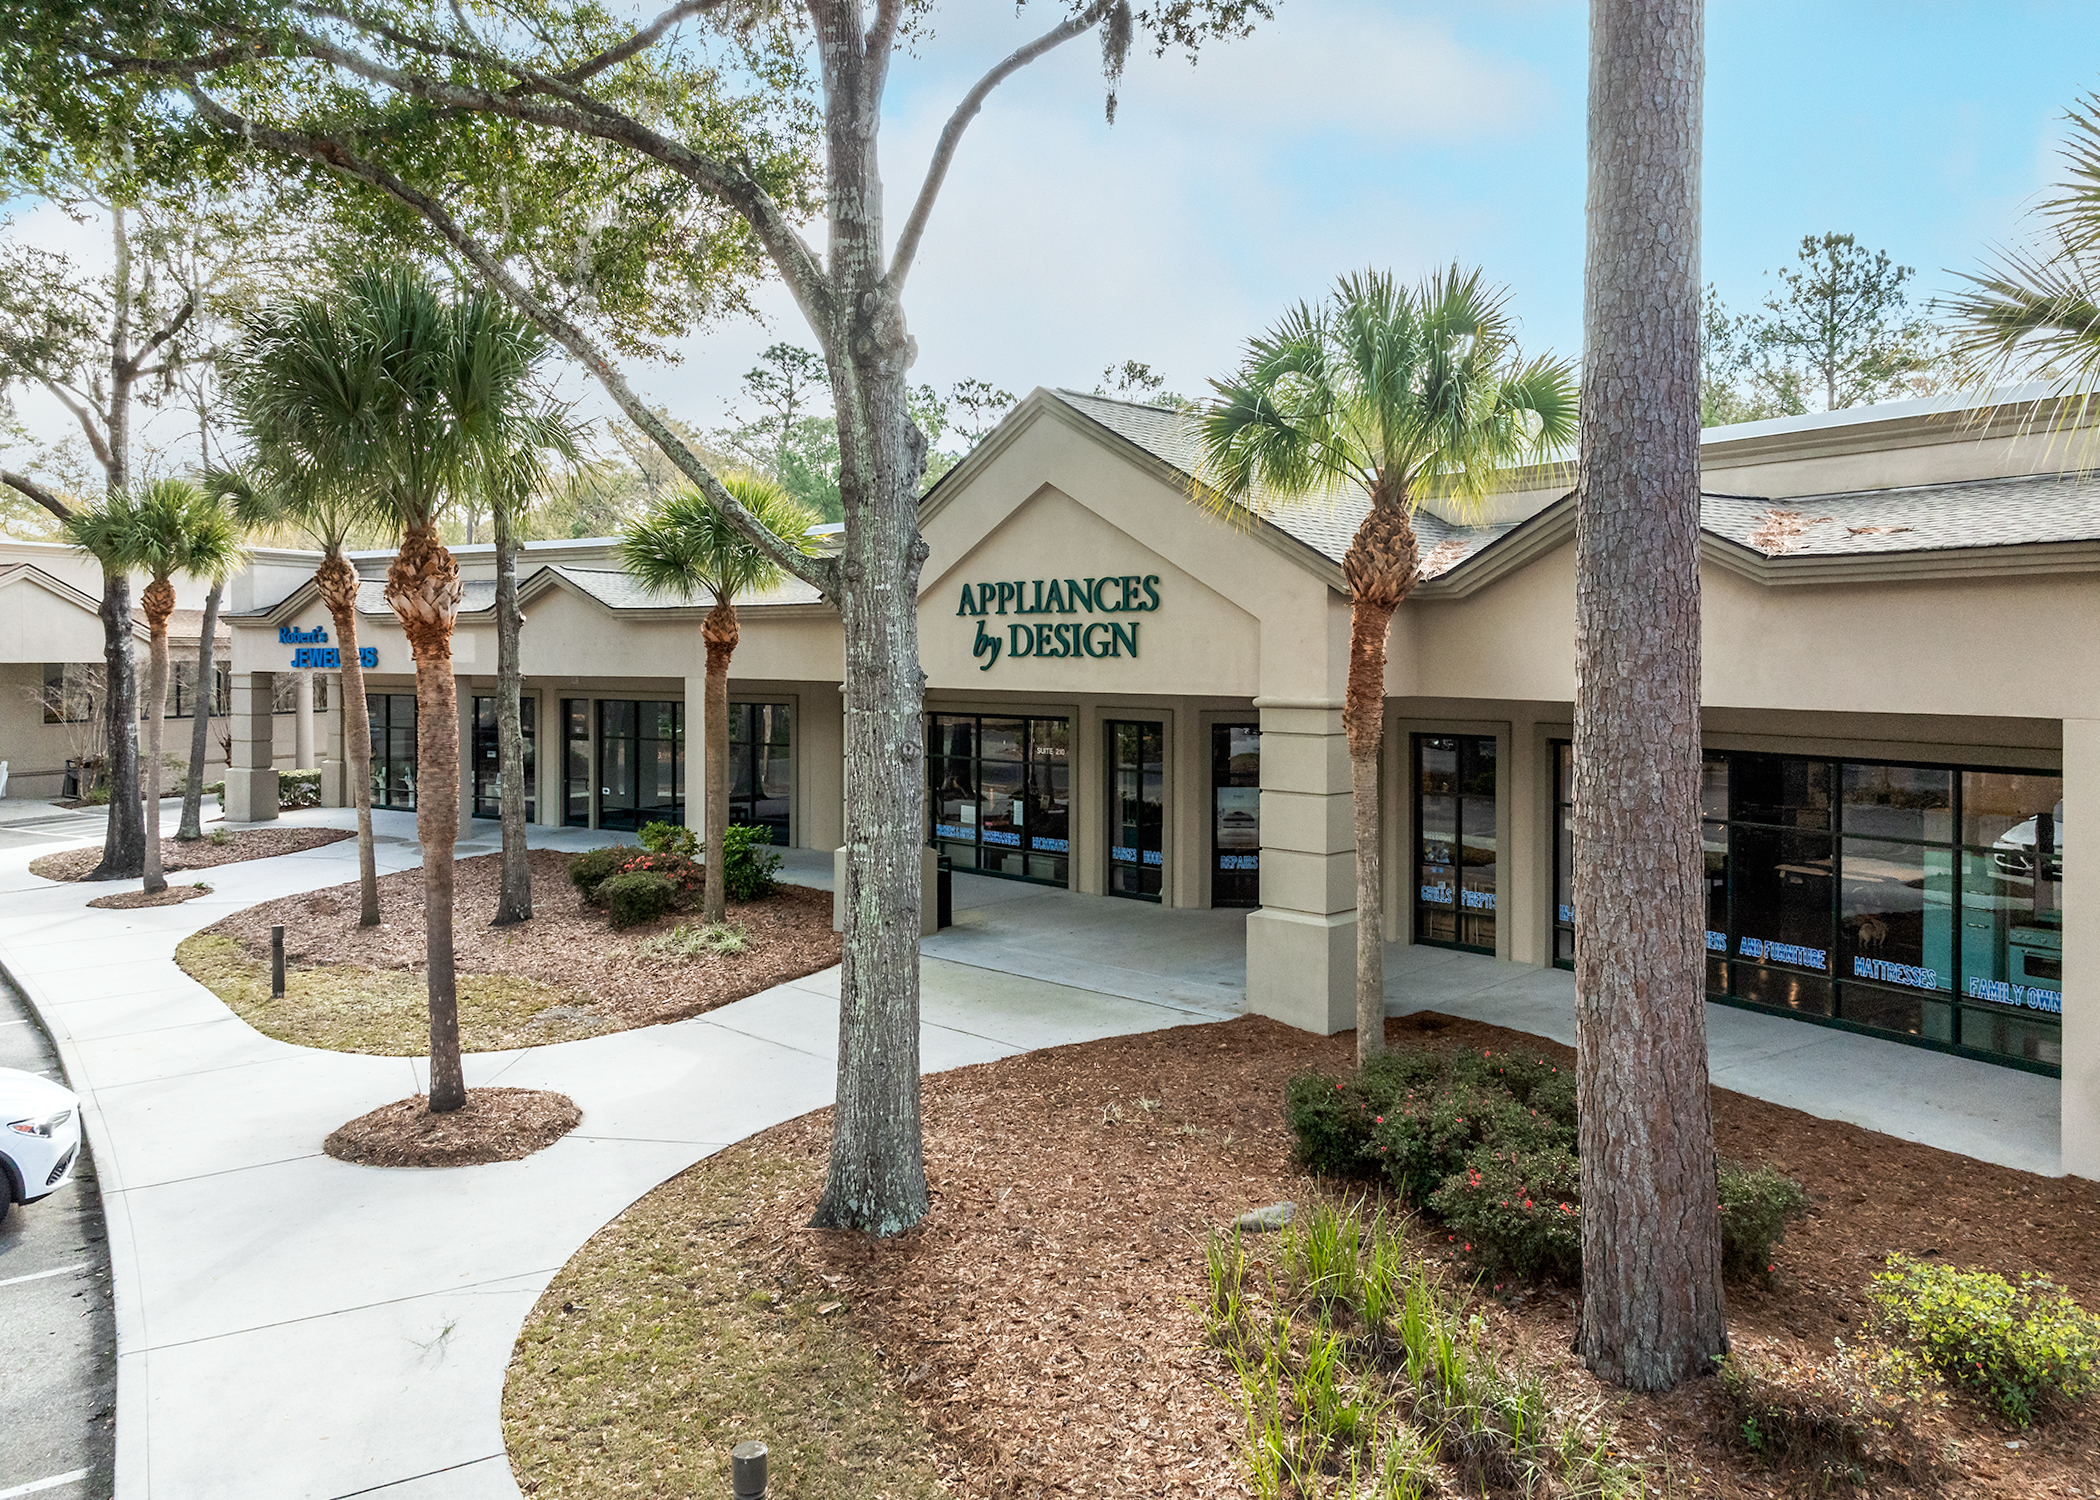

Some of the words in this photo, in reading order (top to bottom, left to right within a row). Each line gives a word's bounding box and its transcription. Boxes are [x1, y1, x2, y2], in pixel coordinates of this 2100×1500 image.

[956, 574, 1160, 616] APPLIANCES
[278, 625, 328, 643] Robert's
[972, 620, 1002, 671] by
[1007, 621, 1140, 658] DESIGN
[290, 647, 378, 668] JEWELRS
[1036, 747, 1053, 755] SUITE
[1220, 855, 1258, 869] REPAIRS
[1421, 885, 1452, 904] GRILLS
[1739, 936, 1763, 957] AND
[1763, 940, 1826, 970] FURNITURE
[1854, 956, 1937, 990] MATTRESSES
[1969, 976, 2024, 1006] FAMILY
